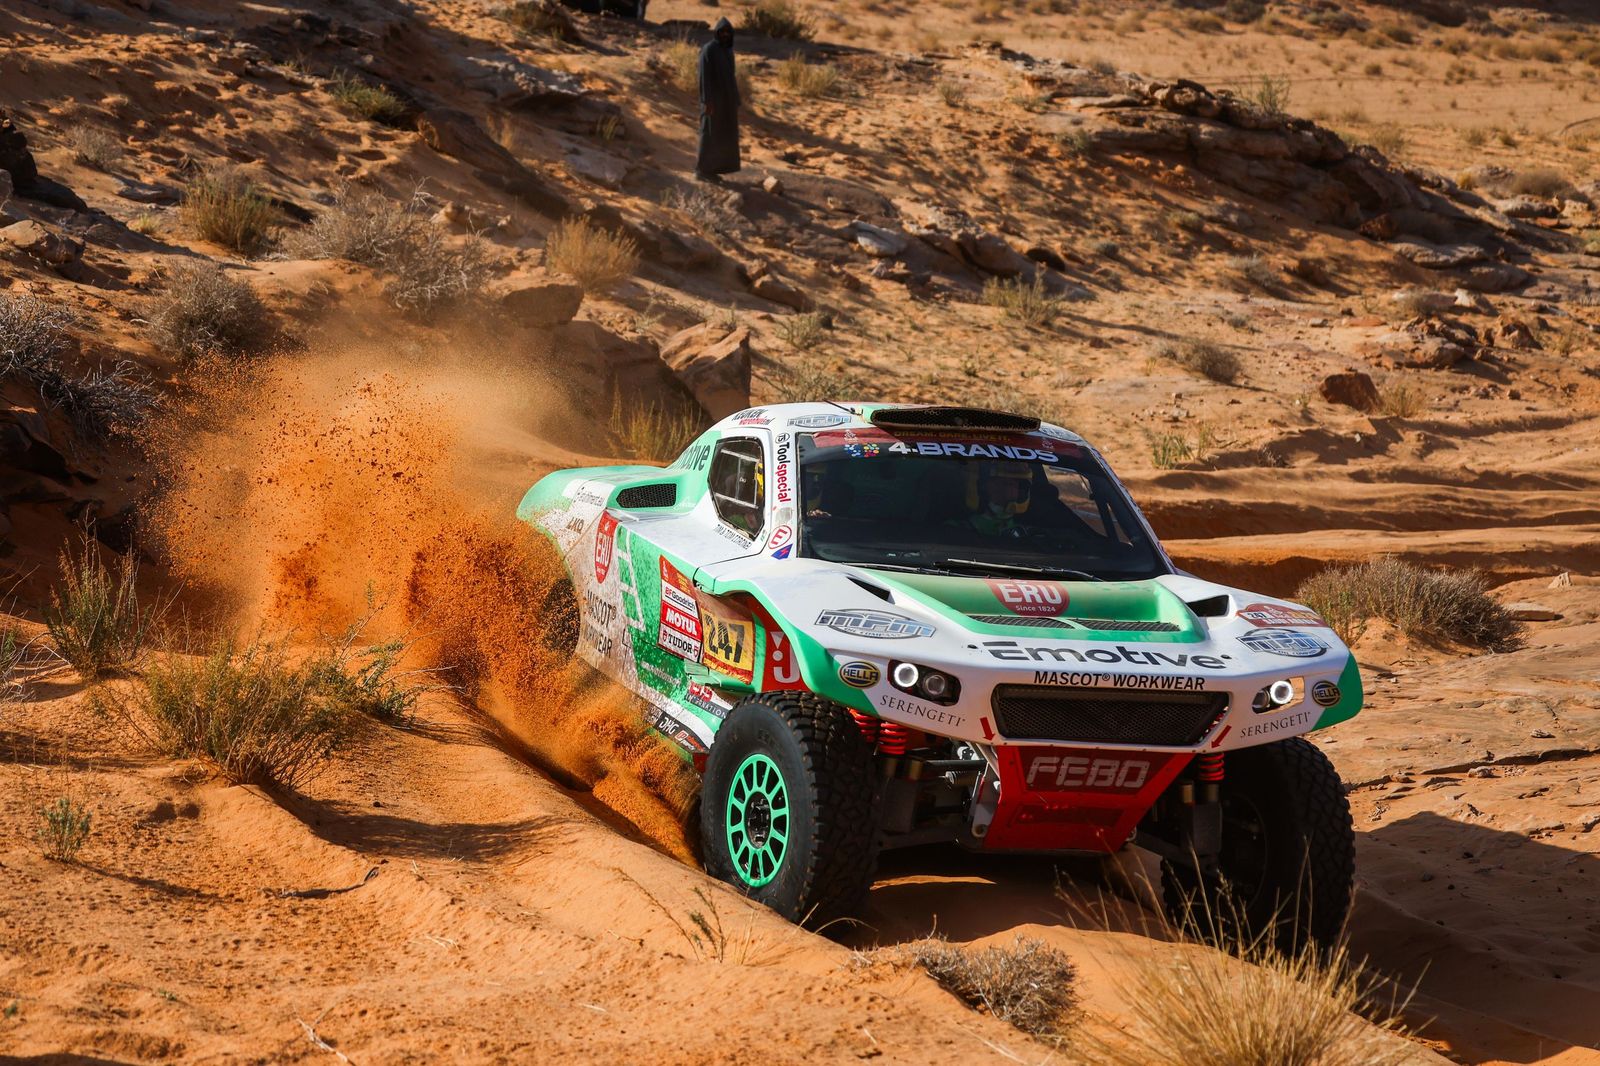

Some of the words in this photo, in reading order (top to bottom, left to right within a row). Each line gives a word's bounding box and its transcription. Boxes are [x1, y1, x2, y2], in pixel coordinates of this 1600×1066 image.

[775, 442, 791, 502] Toolspecial
[665, 586, 696, 609] BFGoodrich
[997, 582, 1062, 605] ERU
[1038, 604, 1056, 612] 1824
[666, 608, 697, 636] MOTUL
[668, 632, 693, 654] TUDOR
[703, 612, 745, 663] 247
[983, 641, 1227, 669] Emotive
[843, 667, 878, 681] HELLA
[1113, 674, 1205, 691] WORKWEAR
[1314, 687, 1340, 698] HELLA
[659, 716, 680, 735] DHG
[1026, 756, 1150, 788] FEBO
